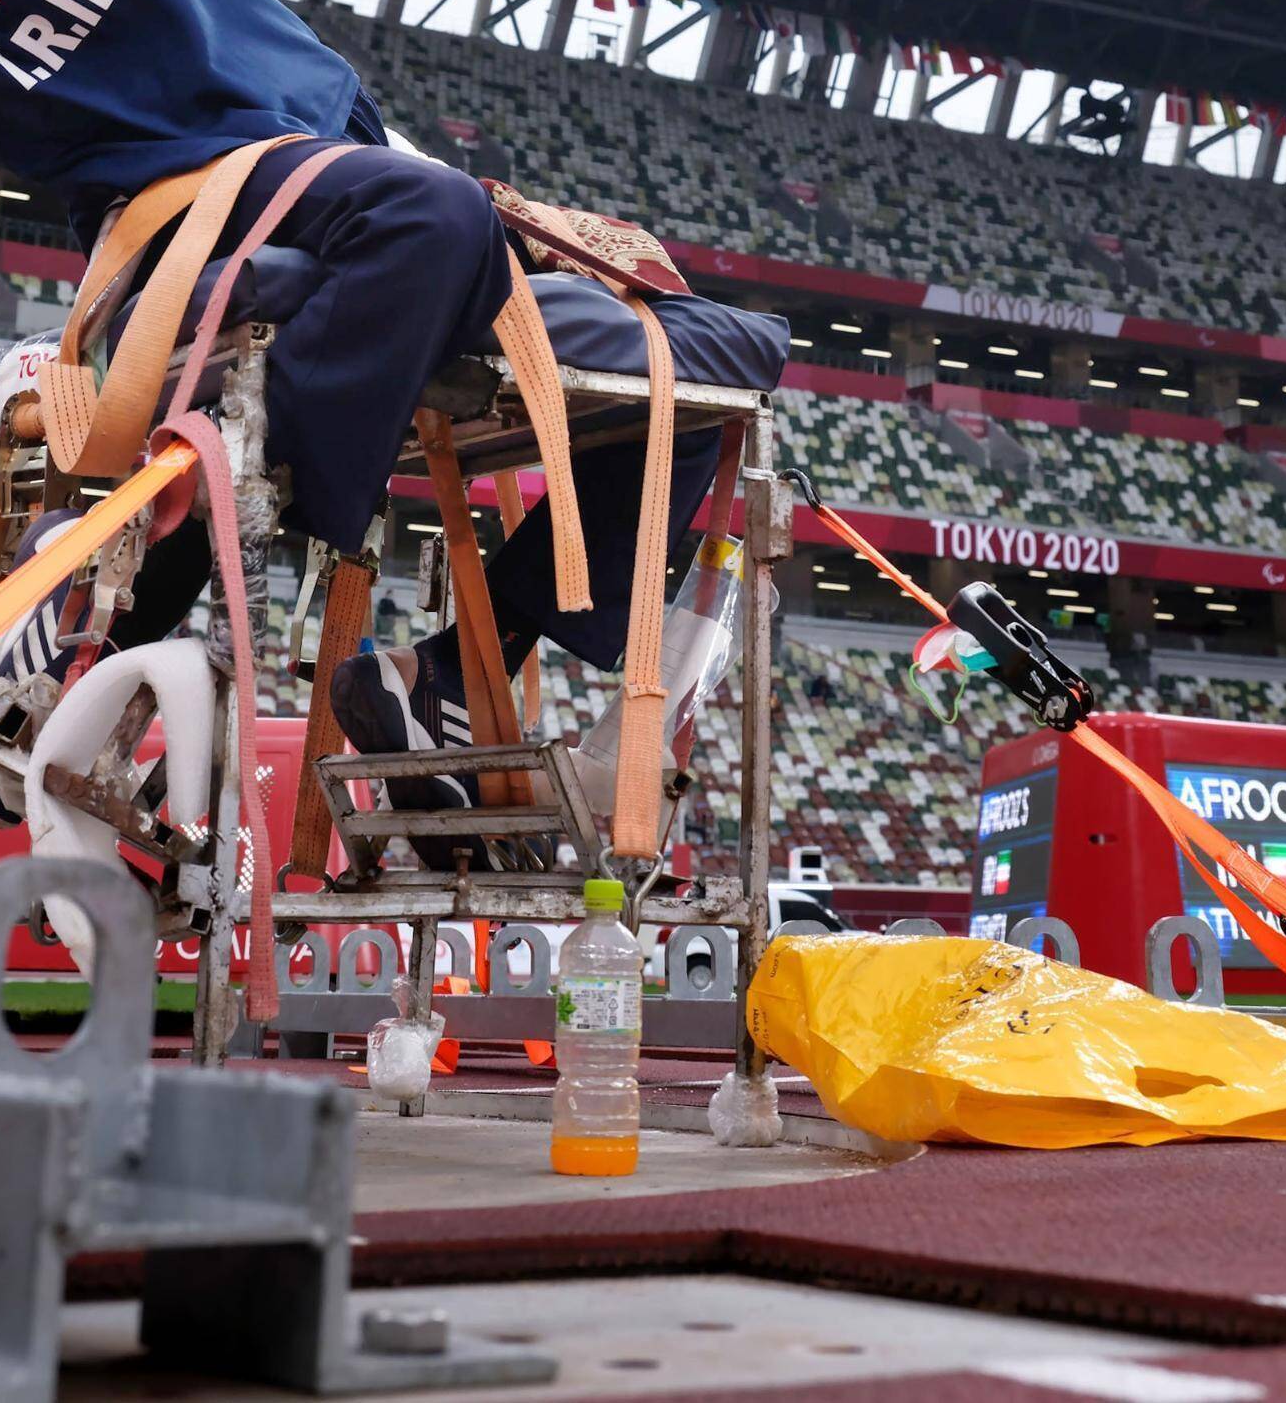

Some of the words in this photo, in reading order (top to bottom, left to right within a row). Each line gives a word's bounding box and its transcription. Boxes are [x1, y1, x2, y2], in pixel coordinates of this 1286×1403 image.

[1039, 301, 1094, 334] 2020
[929, 519, 1038, 567] TOKYO
[1043, 532, 1120, 576] 2020
